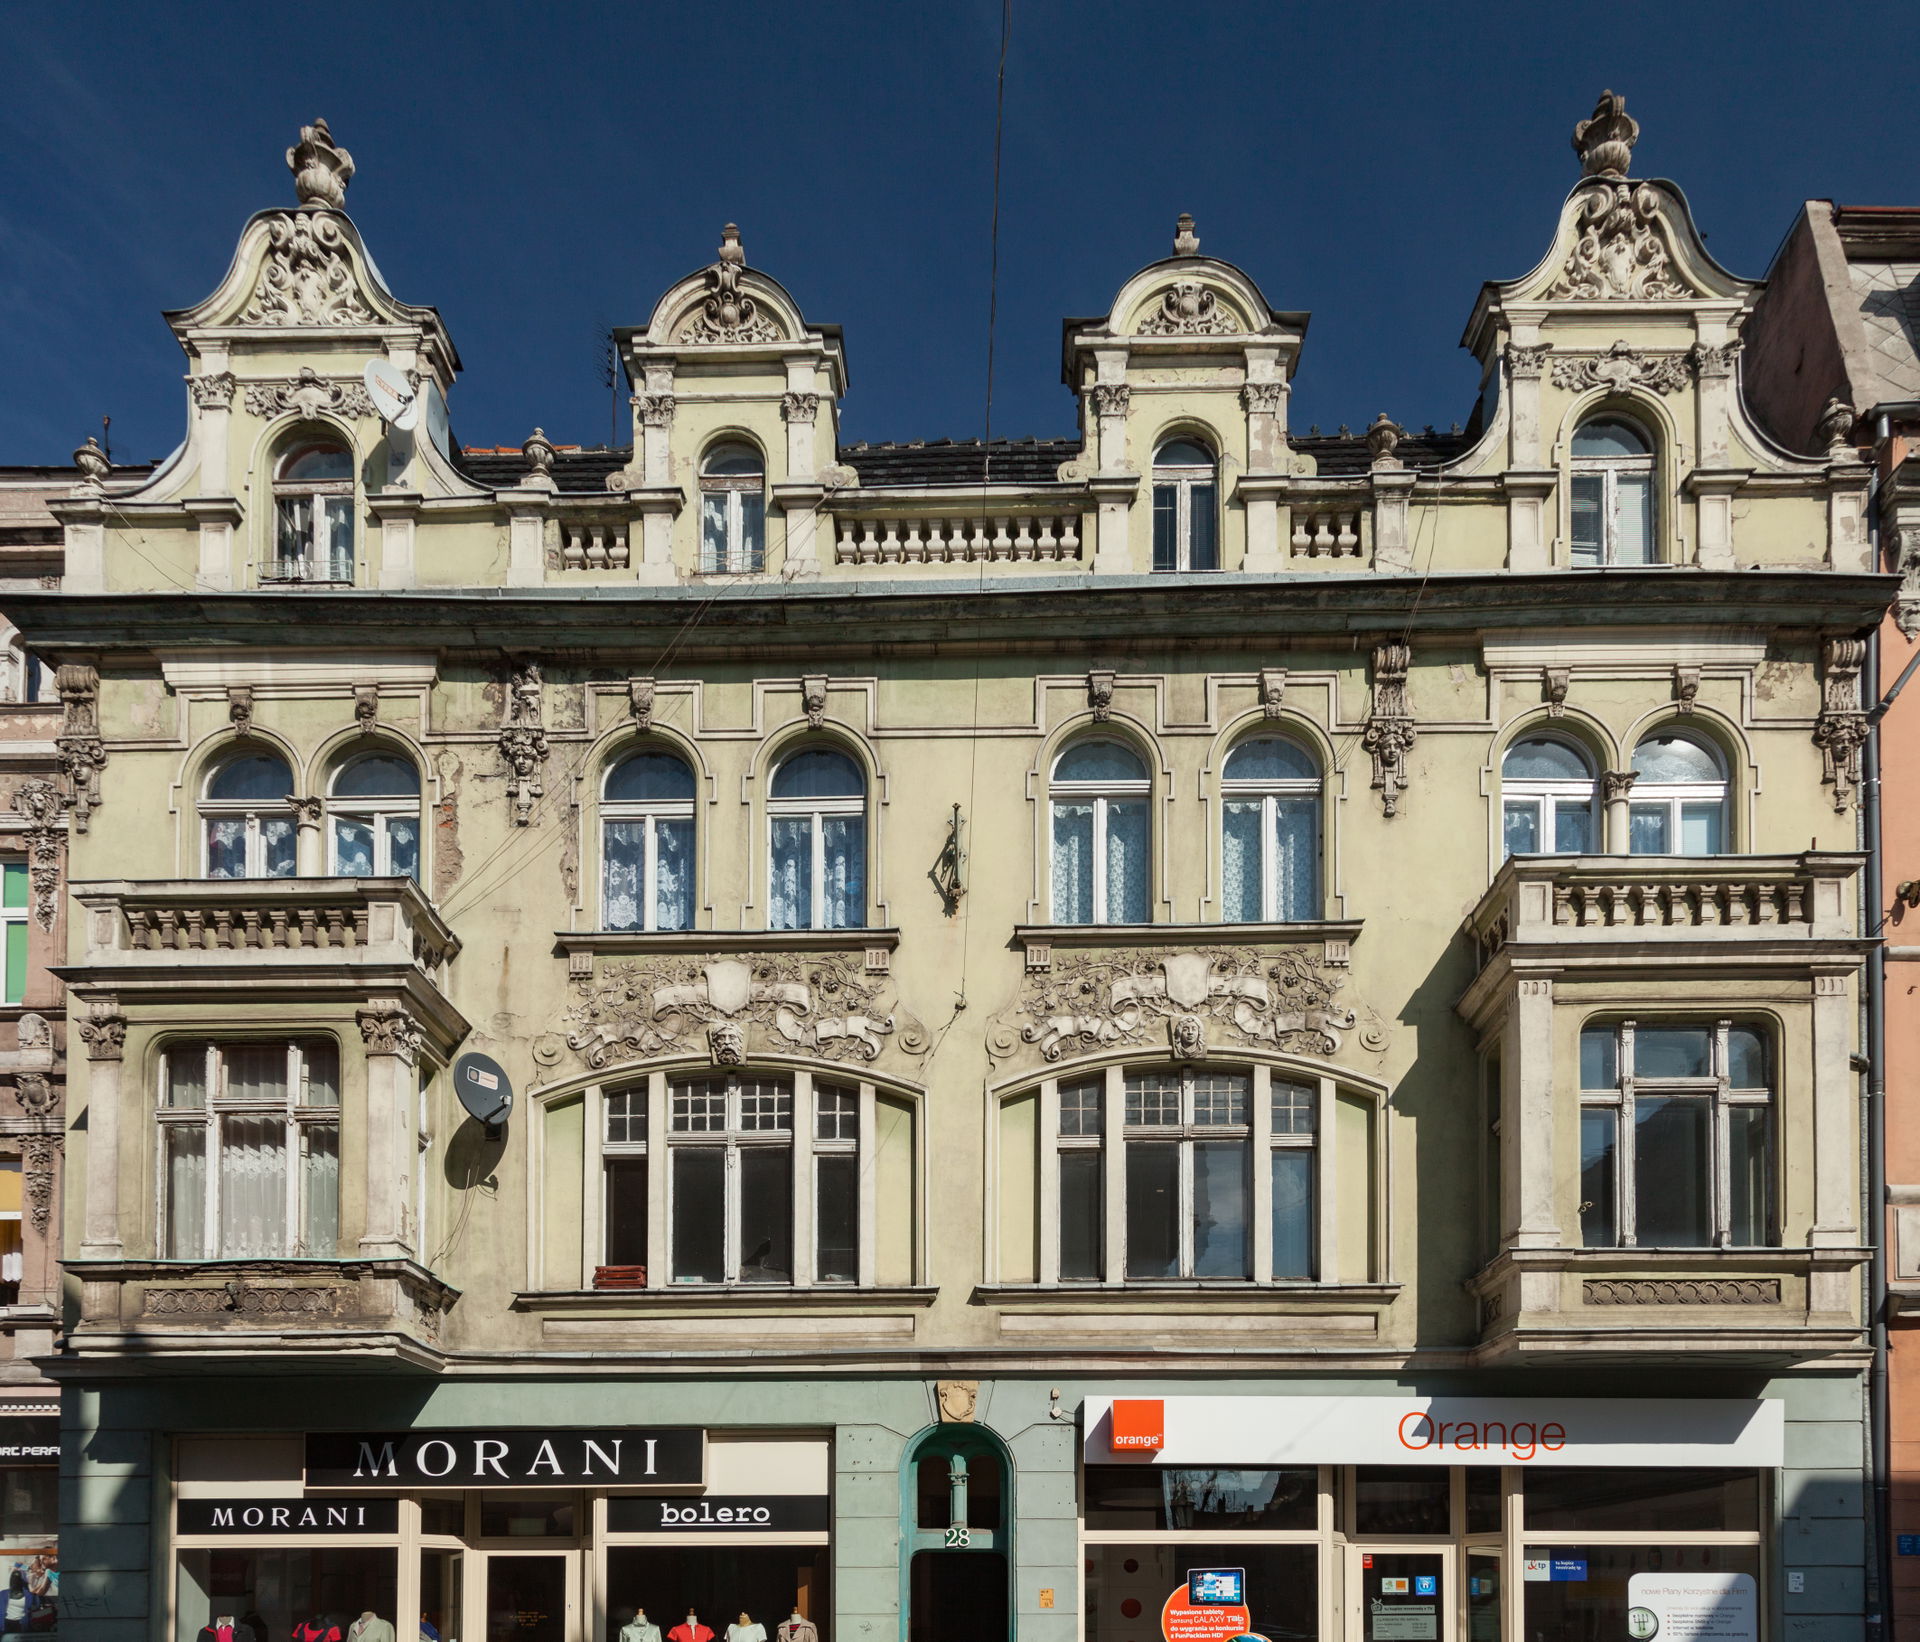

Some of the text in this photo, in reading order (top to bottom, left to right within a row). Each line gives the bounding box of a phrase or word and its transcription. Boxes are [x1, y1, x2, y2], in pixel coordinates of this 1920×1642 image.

[1115, 1436, 1159, 1447] orange
[1398, 1411, 1566, 1461] Orange
[353, 1439, 658, 1479] MORANI
[211, 1506, 366, 1527] MORANI
[661, 1502, 771, 1524] bolero
[945, 1528, 970, 1547] 28
[1538, 1562, 1546, 1570] tp
